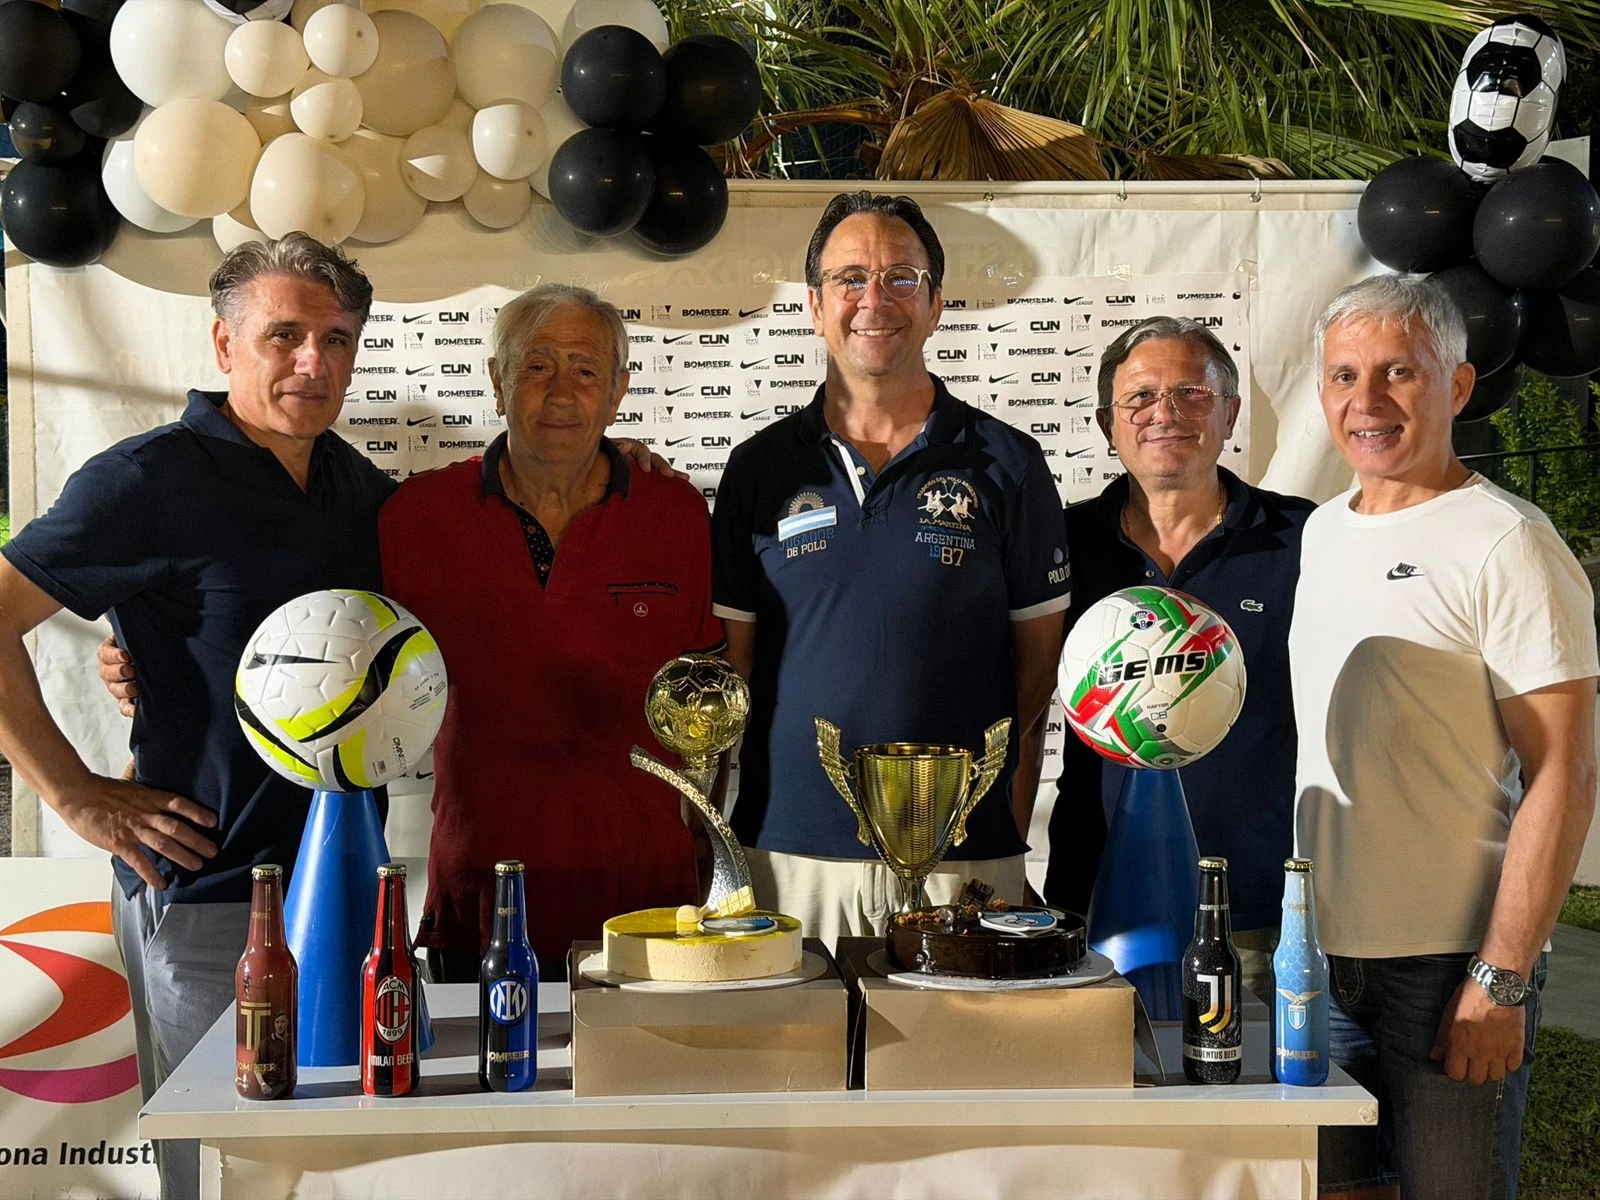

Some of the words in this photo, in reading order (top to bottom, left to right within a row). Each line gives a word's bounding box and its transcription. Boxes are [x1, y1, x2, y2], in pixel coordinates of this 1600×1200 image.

[773, 303, 803, 312] CUN
[439, 312, 469, 322] CUN
[1030, 321, 1060, 331] CUN
[364, 339, 393, 348] CUN
[699, 334, 729, 344] CUN
[775, 354, 804, 364] CUN
[937, 350, 967, 359] CUN
[441, 364, 471, 374] CUN
[1031, 372, 1061, 382] CUN
[366, 390, 396, 400] CUN
[701, 386, 730, 396] CUN
[442, 415, 472, 425] CUN
[1031, 423, 1060, 433] CUN
[367, 441, 397, 451] CUN
[701, 437, 731, 446] CUN
[915, 532, 976, 550] ARGENTINA
[801, 540, 827, 555] POLO
[1394, 562, 1418, 575] NIKE
[382, 979, 406, 993] ACM
[382, 1028, 403, 1037] 1899
[370, 1053, 394, 1066] MILAN
[397, 1053, 415, 1066] BEER
[1192, 1050, 1223, 1060] JUVENTUS
[1224, 1049, 1237, 1059] BEER
[0, 1147, 48, 1165] ona
[59, 1140, 156, 1165] Indust
